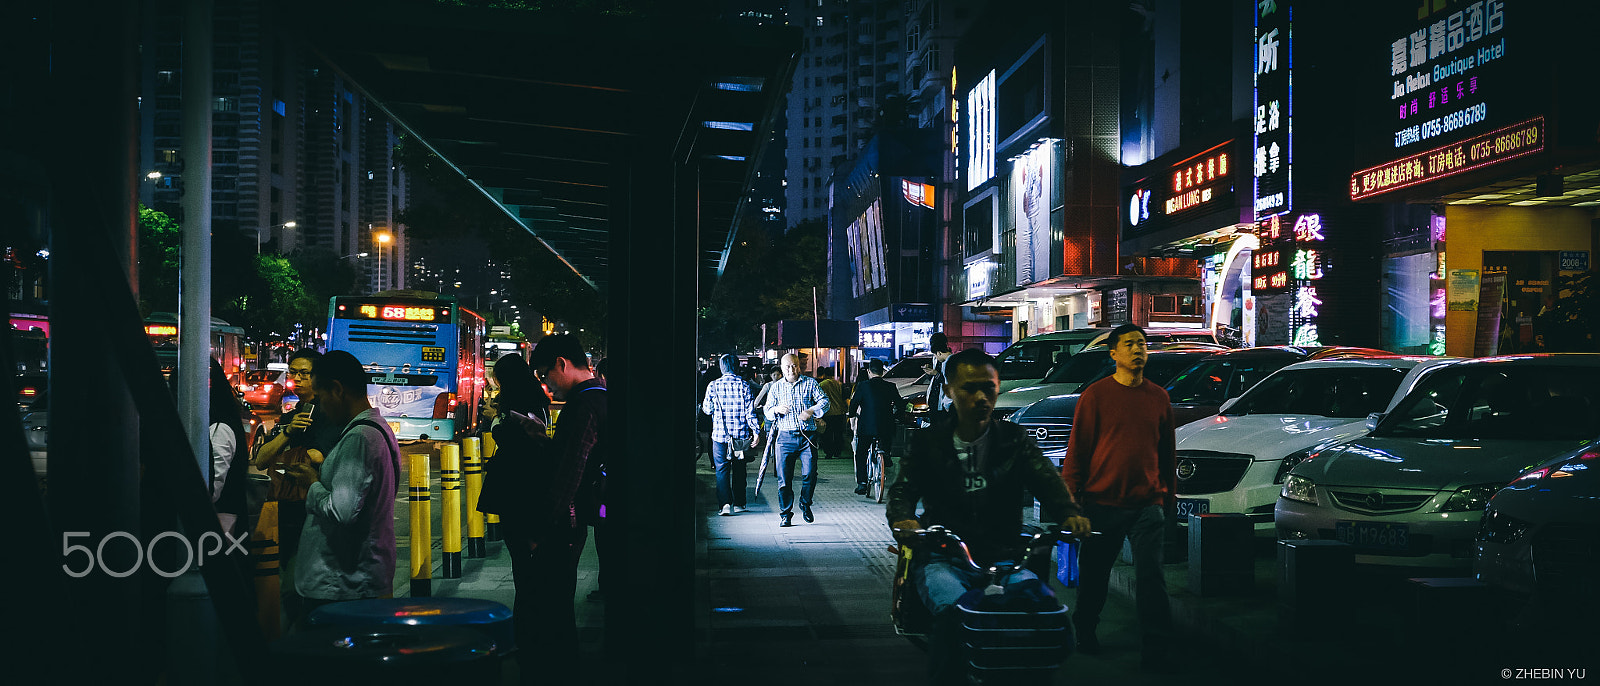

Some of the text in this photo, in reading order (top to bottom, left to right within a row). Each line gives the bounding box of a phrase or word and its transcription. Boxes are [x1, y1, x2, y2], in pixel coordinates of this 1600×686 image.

[1391, 0, 1504, 76] 嘉瑞精品酒店
[1392, 80, 1405, 99] Jia
[1433, 56, 1475, 82] Boutique
[1477, 38, 1505, 66] Hotel
[1400, 76, 1478, 120] 时尚 舒适 乐享
[1184, 189, 1200, 208] LUNG
[383, 306, 405, 318] 58
